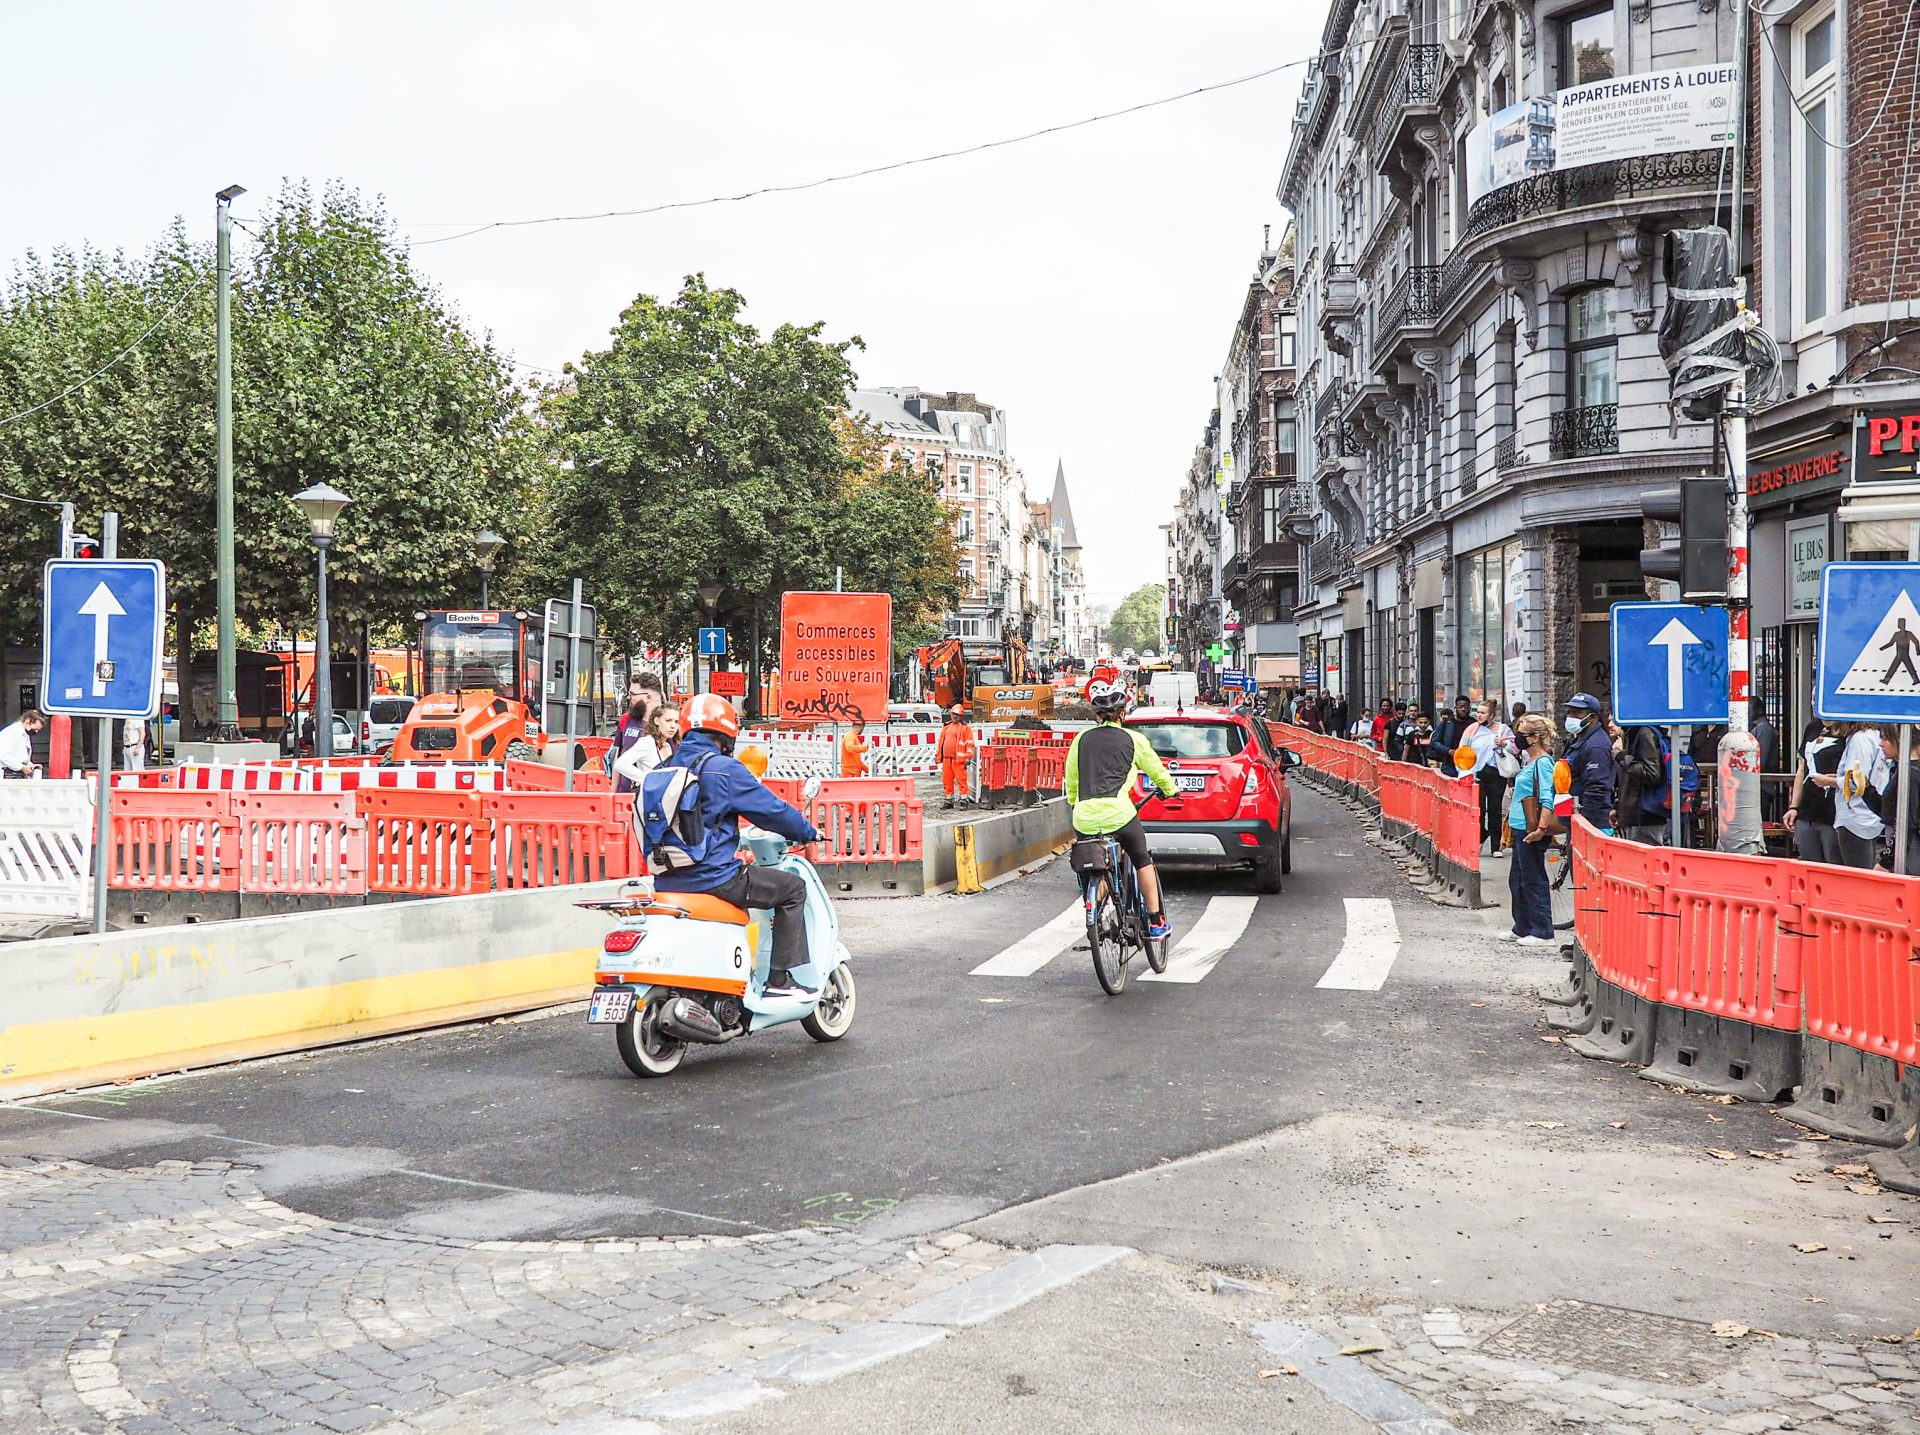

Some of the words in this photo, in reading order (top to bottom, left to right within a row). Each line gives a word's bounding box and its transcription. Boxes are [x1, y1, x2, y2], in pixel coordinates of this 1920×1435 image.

[1562, 77, 1670, 108] APPARTEMENTS
[1674, 72, 1684, 88] À
[1561, 102, 1617, 120] APPARTEMENTS
[1594, 114, 1603, 122] EN
[1605, 109, 1626, 121] PLEIN
[1654, 104, 1665, 112] DE
[1746, 474, 1761, 496] LE
[1761, 466, 1784, 494] BUS
[1784, 450, 1842, 485] TAVERNE
[1794, 542, 1804, 562] LE
[1806, 539, 1824, 560] BUS
[448, 614, 480, 622] Boels
[796, 622, 876, 639] Commerces
[796, 645, 876, 661] accessibles
[787, 669, 809, 682] rue
[816, 666, 883, 683] Souverain
[820, 689, 850, 705] Pont
[994, 690, 1034, 700] CASE
[734, 946, 742, 968] 6
[604, 1008, 626, 1020] 503
